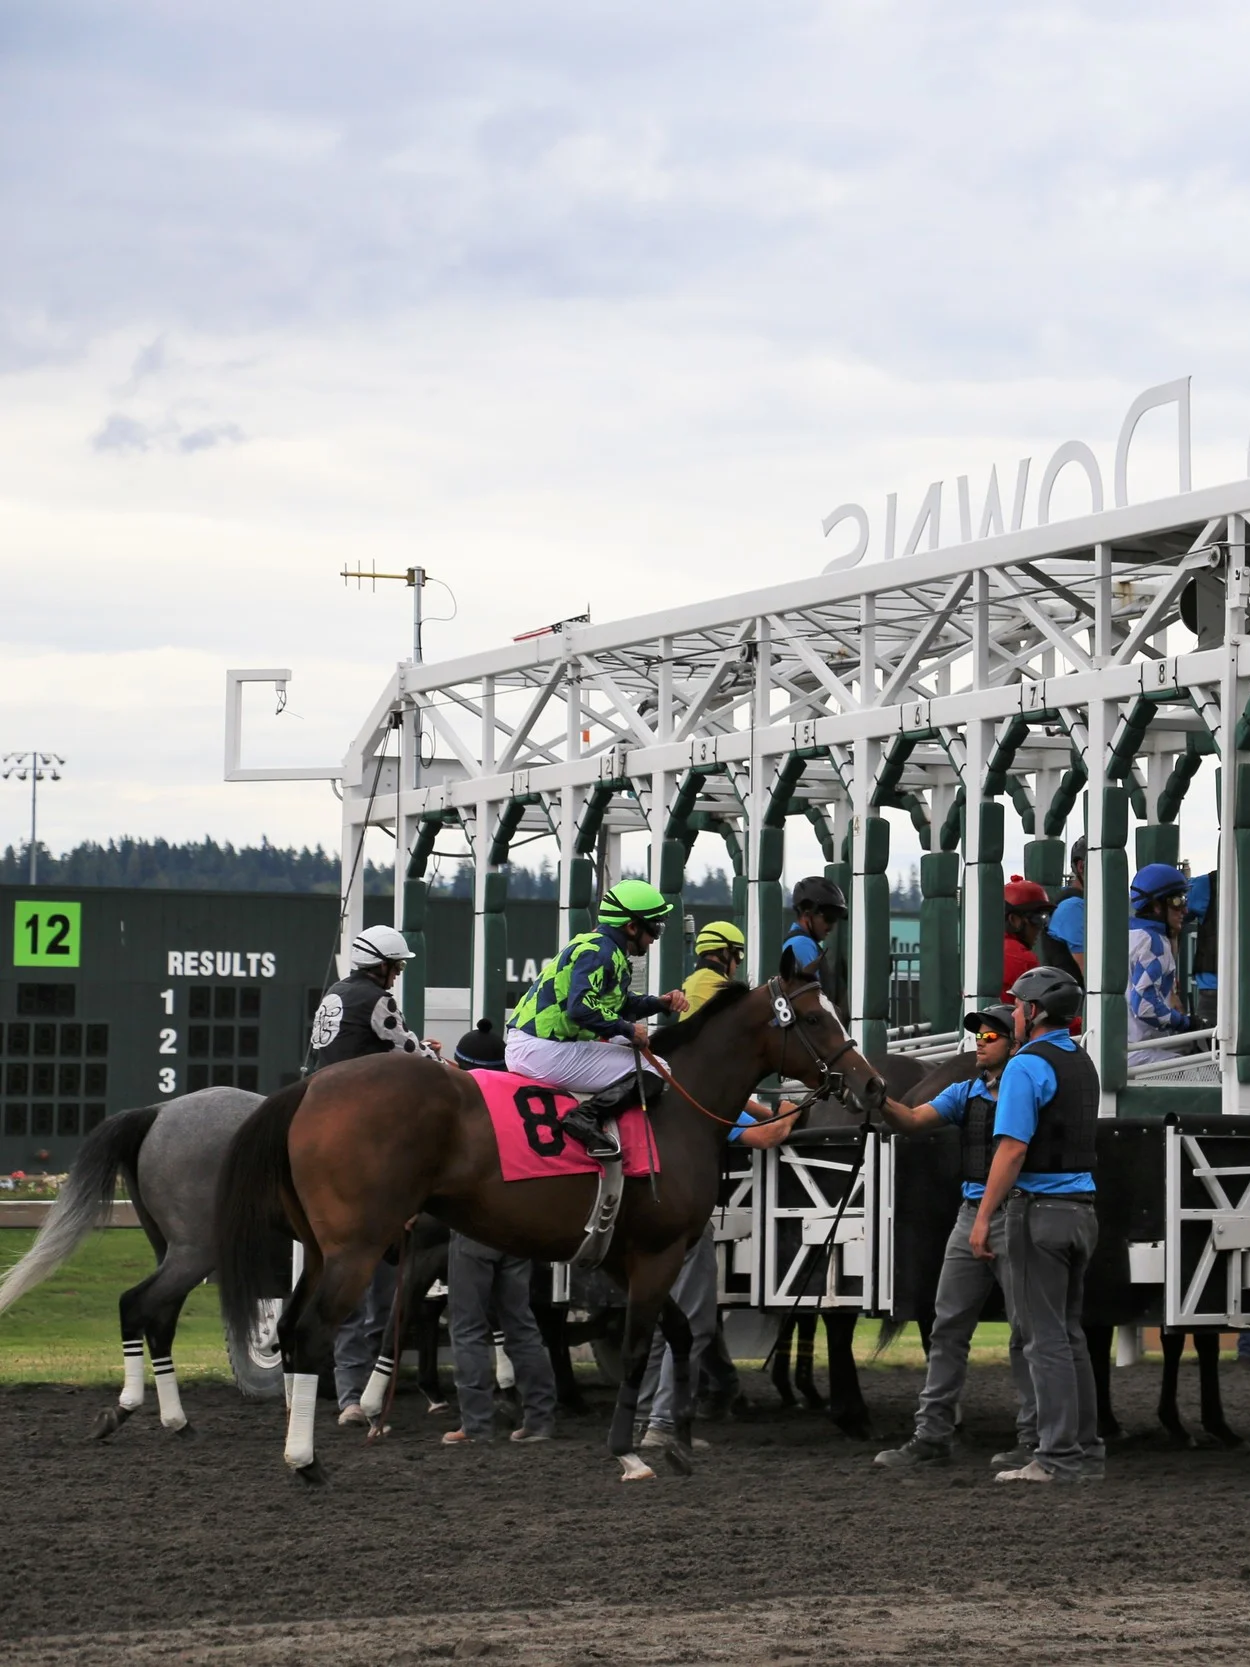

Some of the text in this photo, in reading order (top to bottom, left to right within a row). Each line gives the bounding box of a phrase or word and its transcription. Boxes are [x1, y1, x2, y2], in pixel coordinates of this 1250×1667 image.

[1158, 663, 1166, 684] 8
[1029, 686, 1037, 707] 7
[915, 706, 921, 726] 6
[803, 725, 810, 744] 5
[700, 743, 707, 761] 3
[605, 759, 612, 775] 2
[25, 914, 71, 955] 12
[168, 951, 276, 978] RESULTS
[506, 958, 553, 983] LA
[160, 988, 174, 1015] 1
[774, 997, 792, 1022] 8
[159, 1028, 177, 1054] 2
[158, 1067, 176, 1094] 3
[513, 1085, 567, 1157] 8
